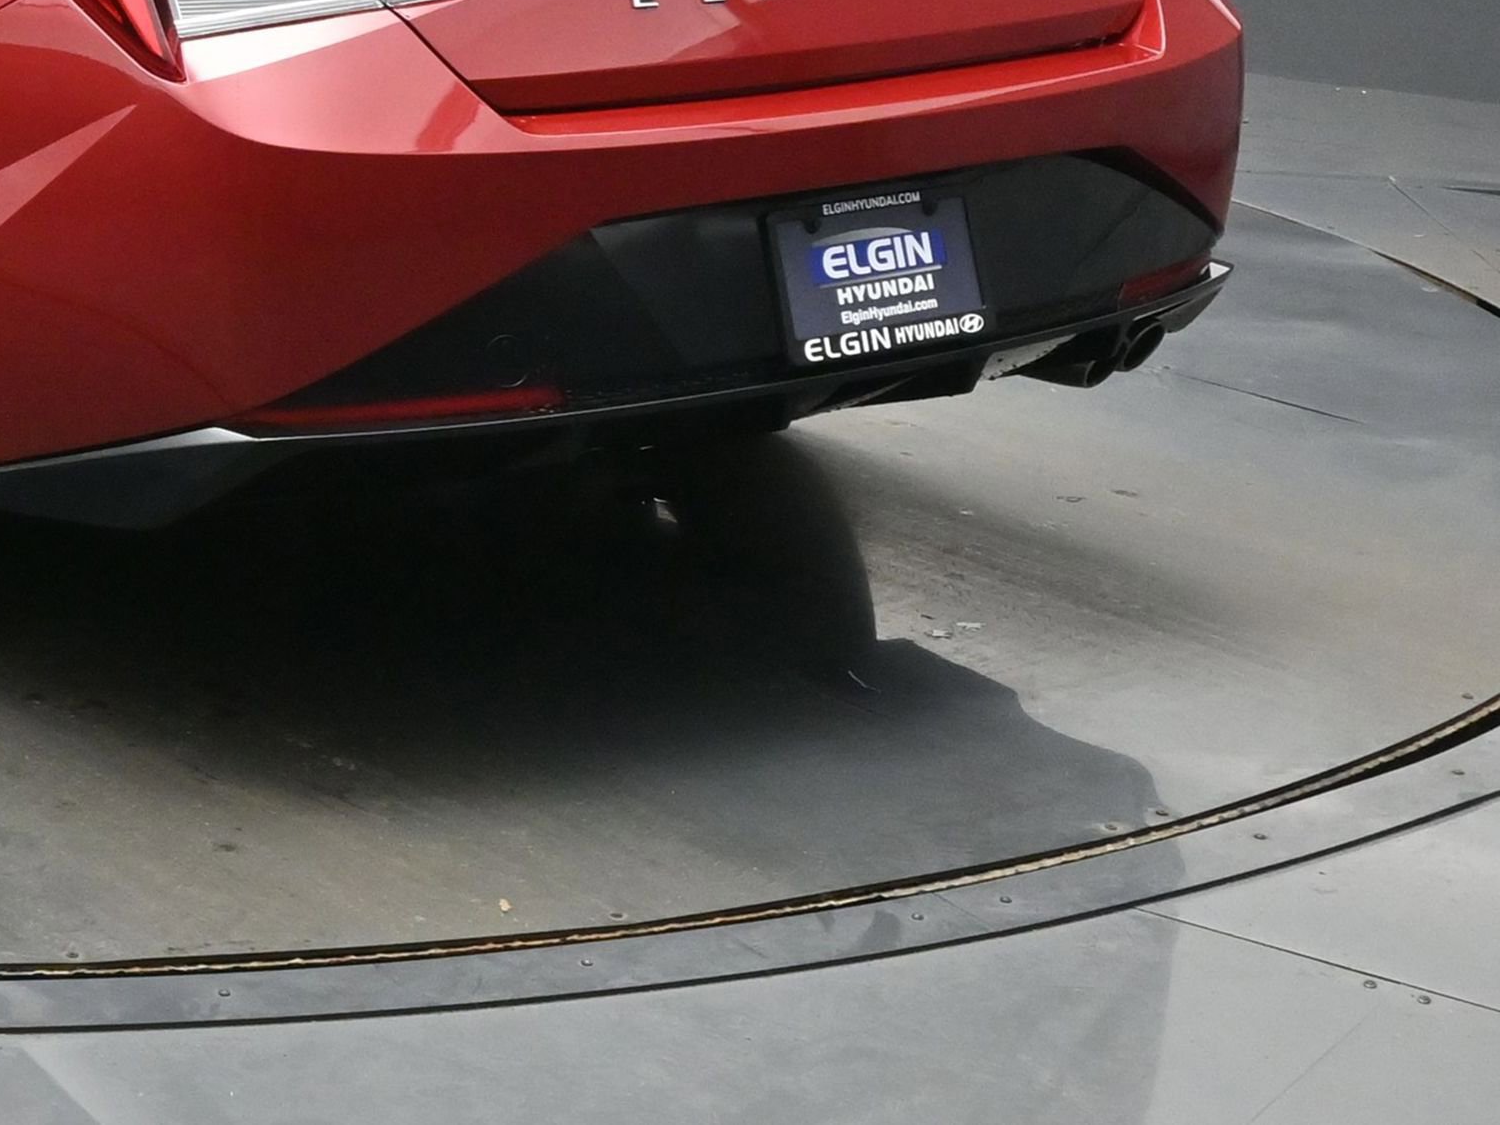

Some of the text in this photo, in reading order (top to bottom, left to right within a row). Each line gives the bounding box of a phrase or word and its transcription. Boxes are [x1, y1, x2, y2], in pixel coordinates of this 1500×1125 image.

[822, 191, 921, 216] ELGINHYUNDAI.COM
[822, 232, 934, 279] ELGIN
[836, 273, 935, 305] HYUNDAI
[840, 298, 938, 325] ElginHyundai.com
[804, 317, 960, 362] ELGIN HYUNDAI
